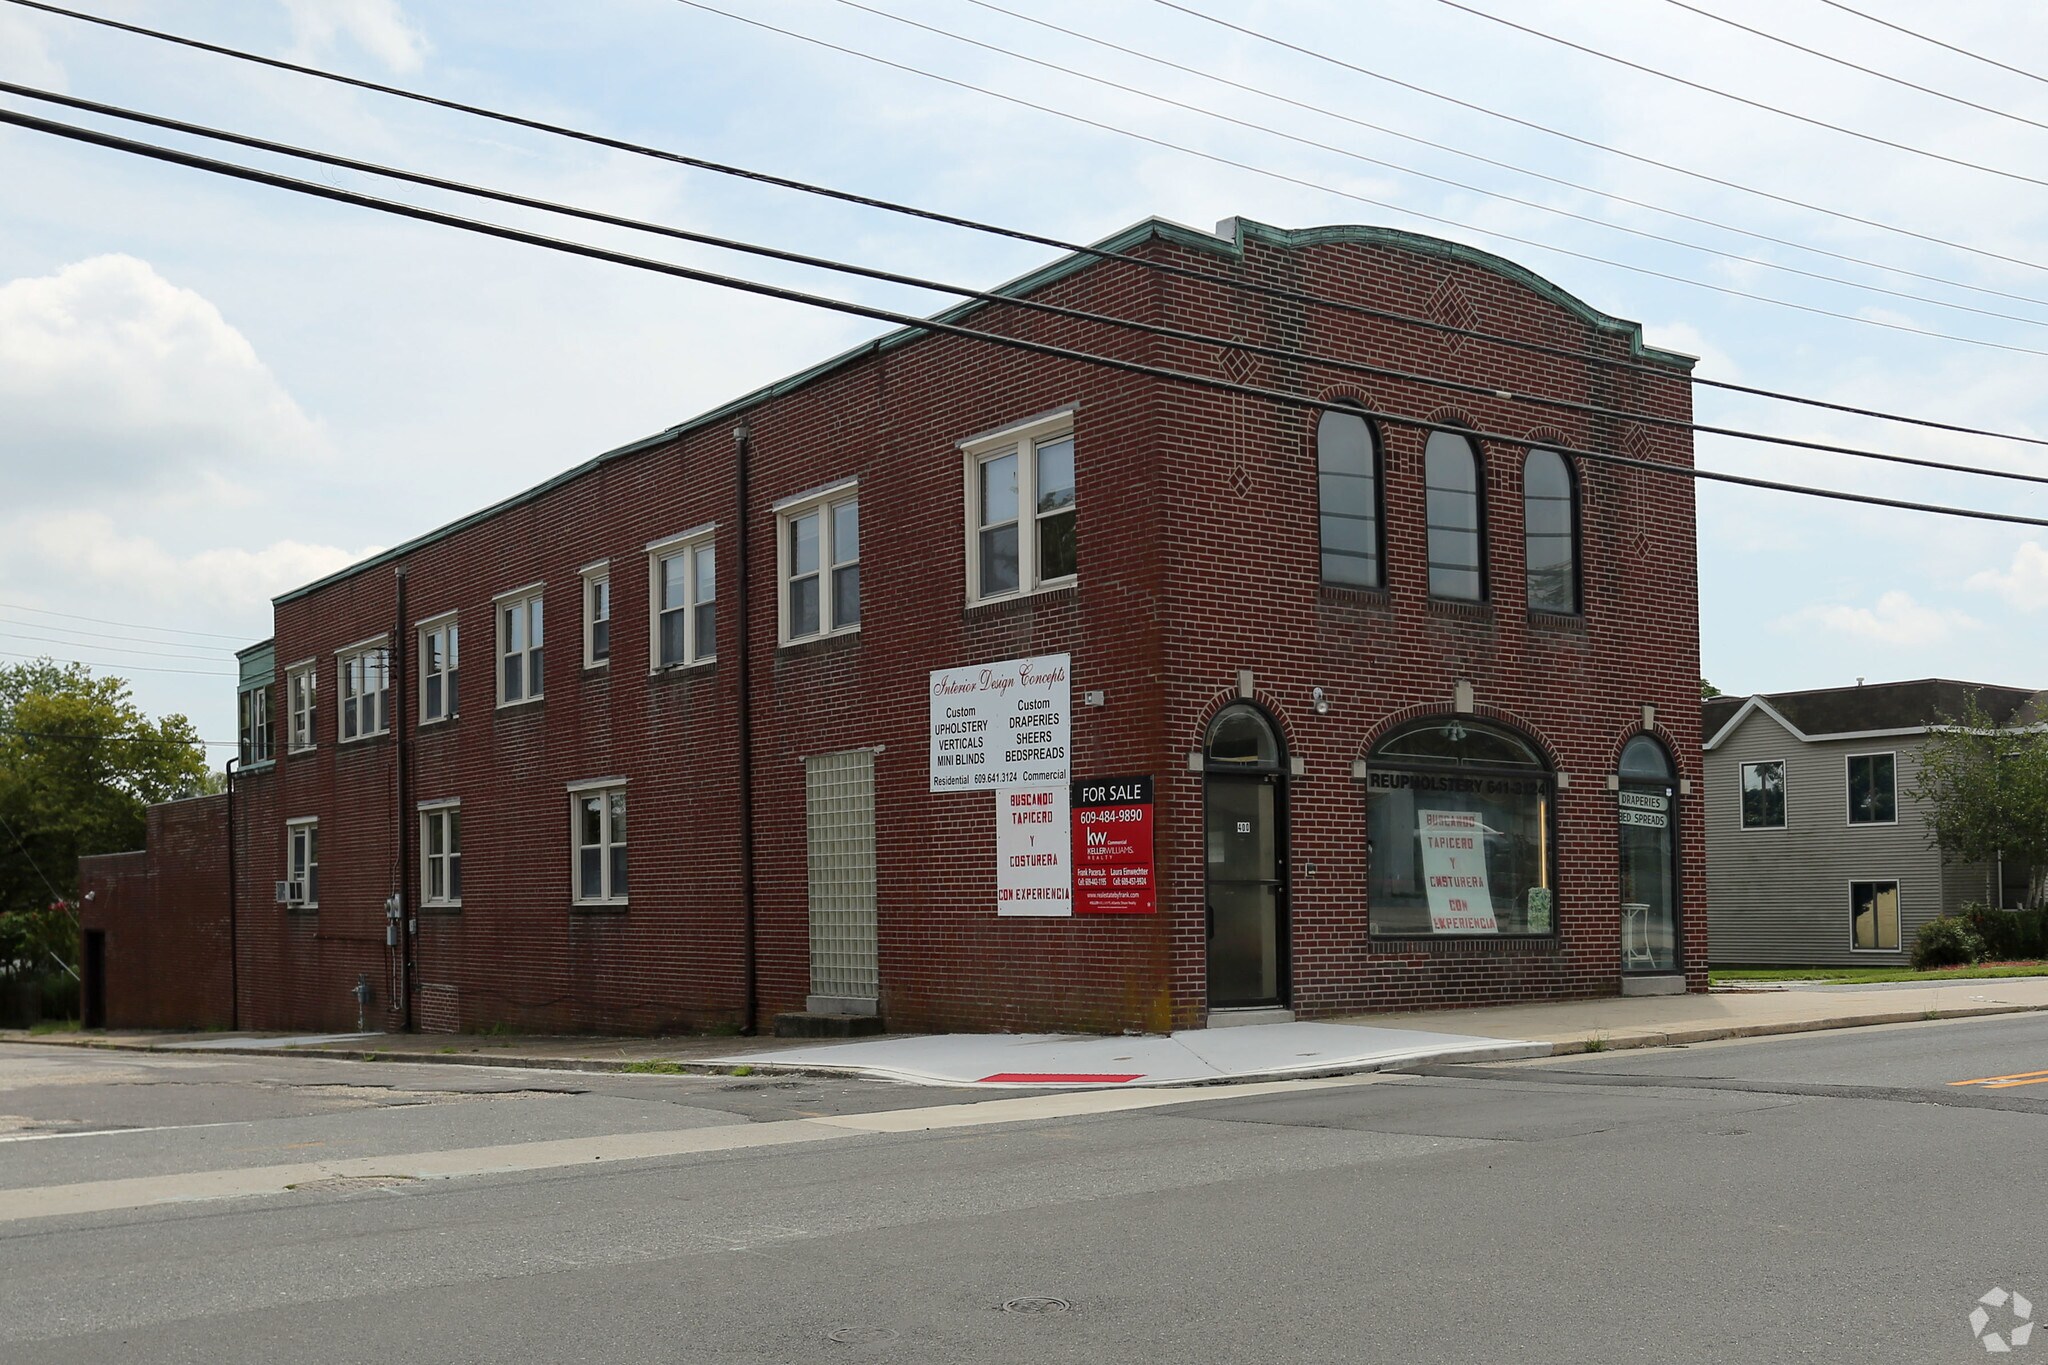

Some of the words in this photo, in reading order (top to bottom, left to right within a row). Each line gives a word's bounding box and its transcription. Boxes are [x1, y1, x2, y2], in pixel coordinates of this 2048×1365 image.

[933, 675, 976, 697] Interior
[979, 669, 1015, 697] Design
[1019, 663, 1065, 690] Concepts
[946, 707, 976, 718] Custom
[1017, 699, 1050, 711] Custom
[934, 720, 988, 735] UPHOLSTERY
[1009, 713, 1060, 729] DRAPERIES
[939, 737, 984, 751] VERTICALS
[1016, 730, 1052, 745] SHEERS
[937, 755, 954, 767] MINI
[955, 752, 985, 766] BLINDS
[1005, 746, 1065, 763] BEDSPREADS
[933, 775, 970, 786] Residential
[974, 771, 1018, 784] 609.641.3124
[1022, 769, 1067, 781] Commercial
[1370, 773, 1483, 793] REUPHOLSTERY
[1010, 792, 1053, 807] BUSCANDO
[1082, 787, 1106, 803] FOR
[1109, 784, 1142, 801] SALE
[1622, 794, 1661, 808] DRAPERIES
[1012, 811, 1053, 825] TAPICERO
[1080, 808, 1142, 825] 609-484-9890
[1634, 813, 1664, 826] SPREADS
[1238, 823, 1249, 831] 400
[1029, 835, 1035, 847] Y
[1087, 826, 1107, 846] kw
[1428, 837, 1474, 849] TAPICERO
[1009, 853, 1058, 868] COSTURERA
[1449, 857, 1456, 869] Y
[998, 888, 1013, 901] CON
[1015, 887, 1070, 900] EXPERIENCIA
[1448, 899, 1468, 911] CON
